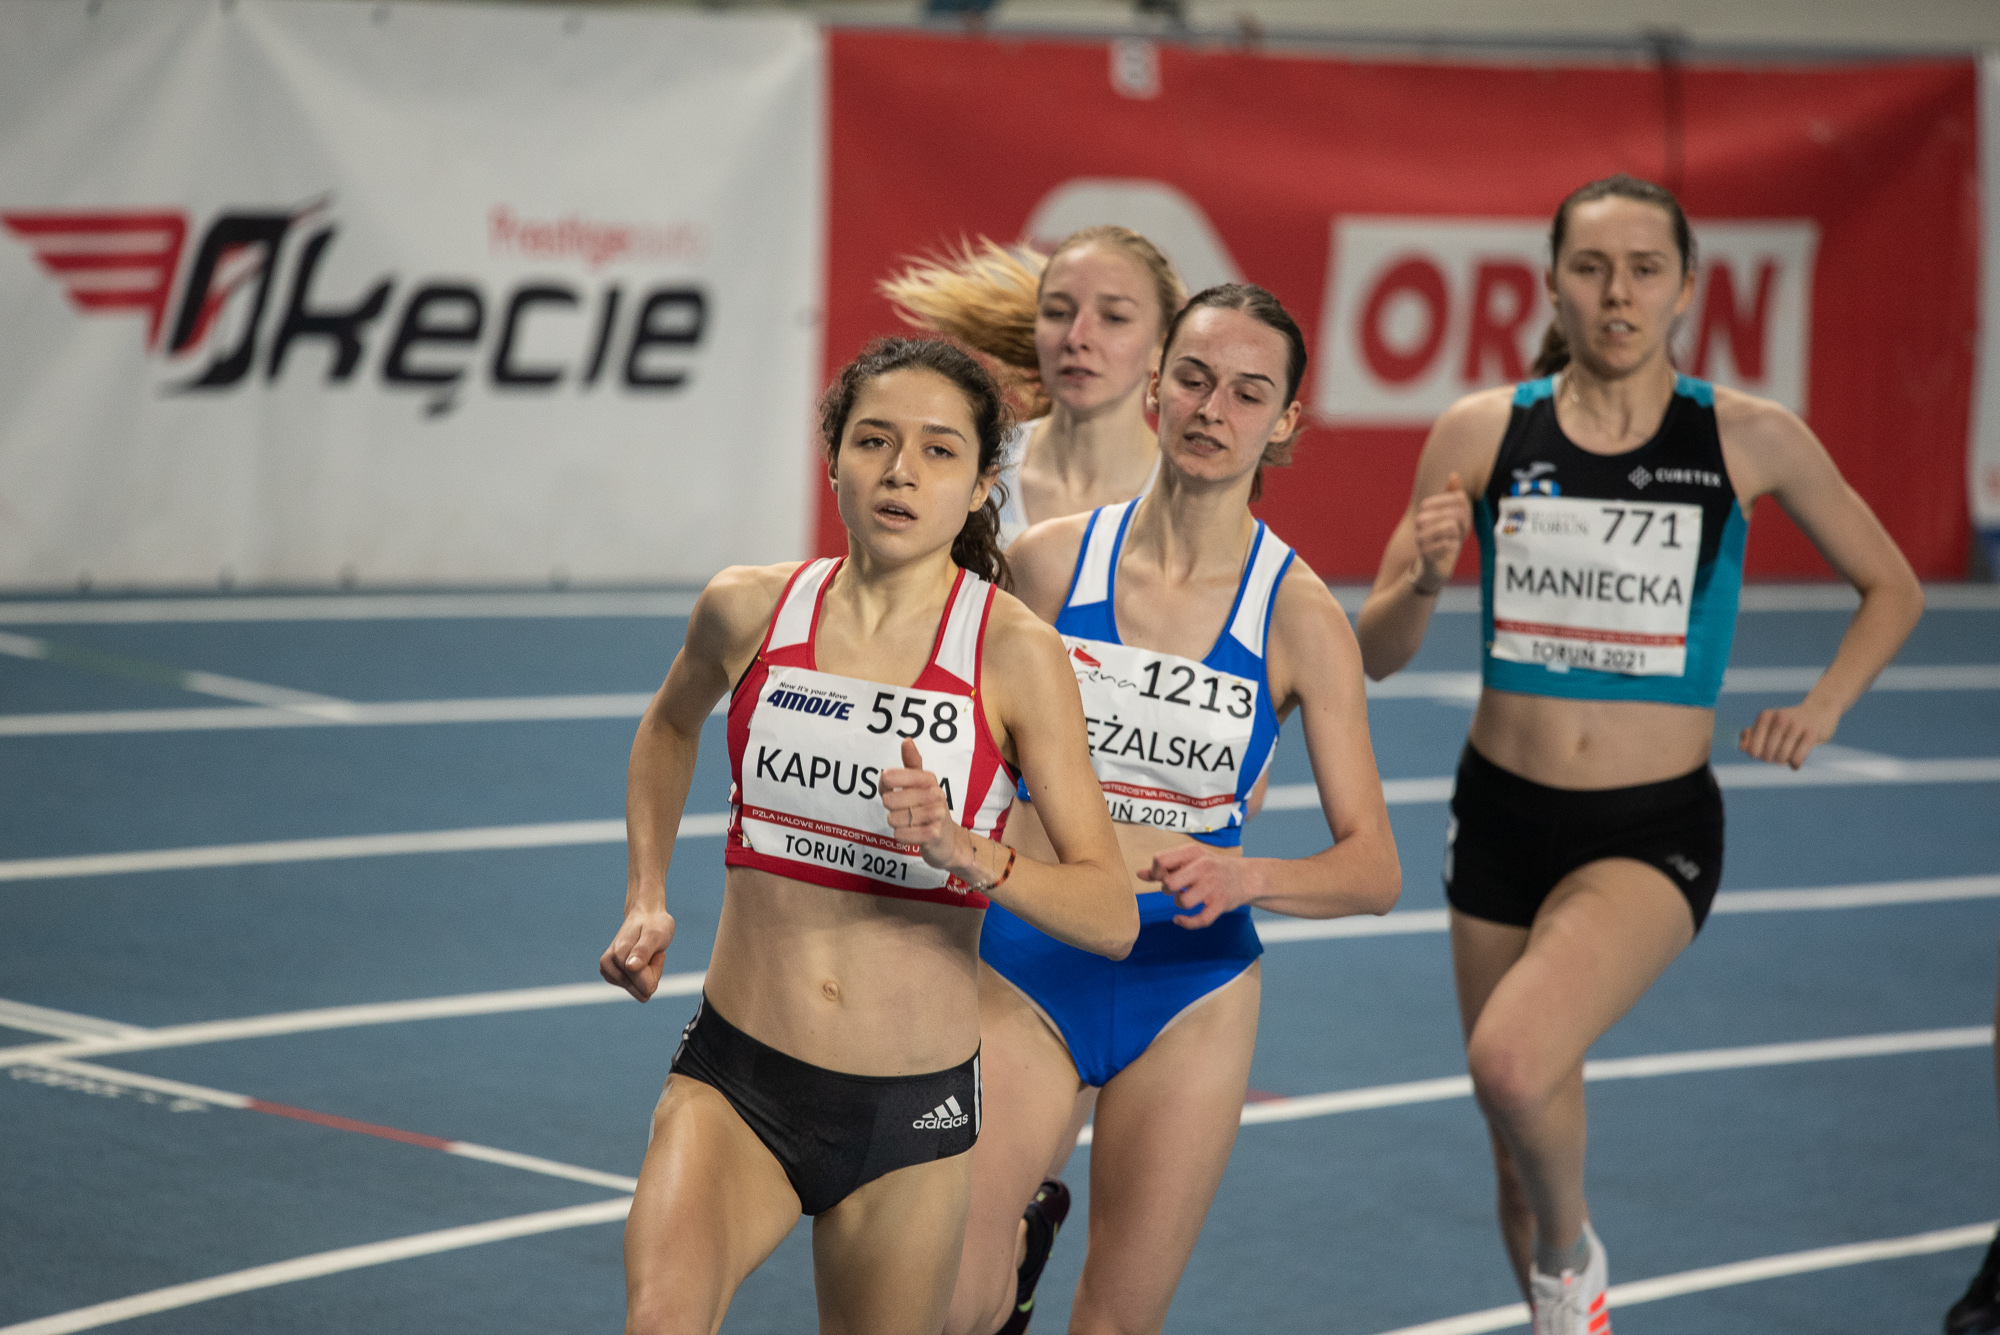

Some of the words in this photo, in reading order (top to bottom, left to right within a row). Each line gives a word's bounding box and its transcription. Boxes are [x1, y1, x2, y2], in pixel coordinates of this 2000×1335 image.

[1360, 254, 1779, 388] ORN
[1602, 508, 1682, 548] 771
[1505, 564, 1683, 606] MANIECKA
[1602, 648, 1646, 669] 2021
[767, 689, 855, 721] 4MOVE
[779, 682, 795, 690] Now
[810, 688, 827, 696] your
[828, 691, 848, 700] Move
[1139, 661, 1252, 719] 1213
[866, 691, 958, 743] 558
[756, 745, 954, 811] KAPUSA
[752, 808, 776, 821] PZLA
[776, 815, 814, 829] HALOWE
[815, 823, 878, 844] MISTRZOSTWA
[879, 838, 911, 852] POLSKI
[1140, 806, 1188, 828] 2021
[785, 834, 856, 868] TORUŃ
[861, 853, 908, 881] 2021
[912, 1114, 969, 1129] adidas
